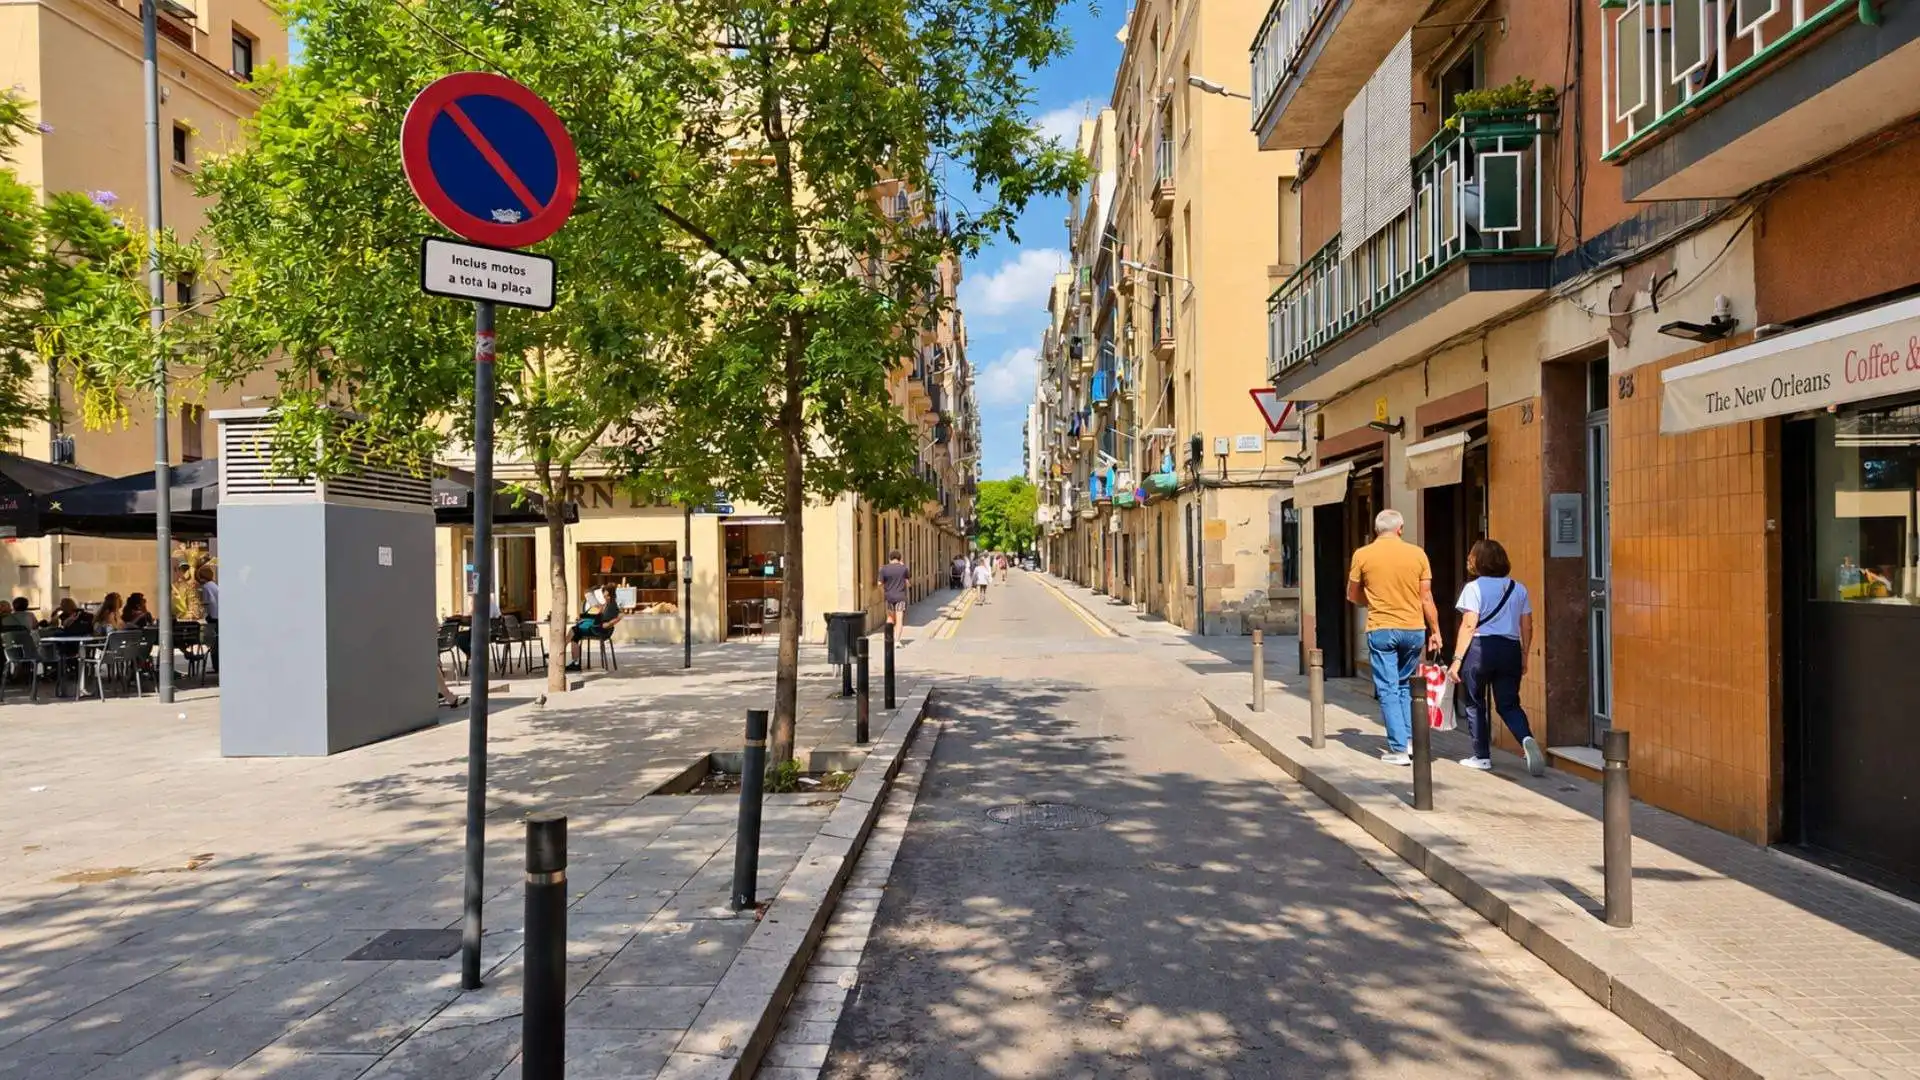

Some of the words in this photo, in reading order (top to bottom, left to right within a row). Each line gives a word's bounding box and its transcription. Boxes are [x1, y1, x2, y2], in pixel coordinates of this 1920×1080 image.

[451, 254, 487, 270] Inclus
[491, 262, 526, 276] motos
[448, 274, 456, 284] a
[460, 275, 483, 288] tota
[487, 278, 497, 290] la
[501, 281, 532, 296] plaça
[1705, 391, 1730, 414] The
[1734, 385, 1767, 409] New
[1771, 373, 1831, 400] Orleans
[1844, 342, 1900, 384] Coffee
[1905, 335, 1920, 371] &
